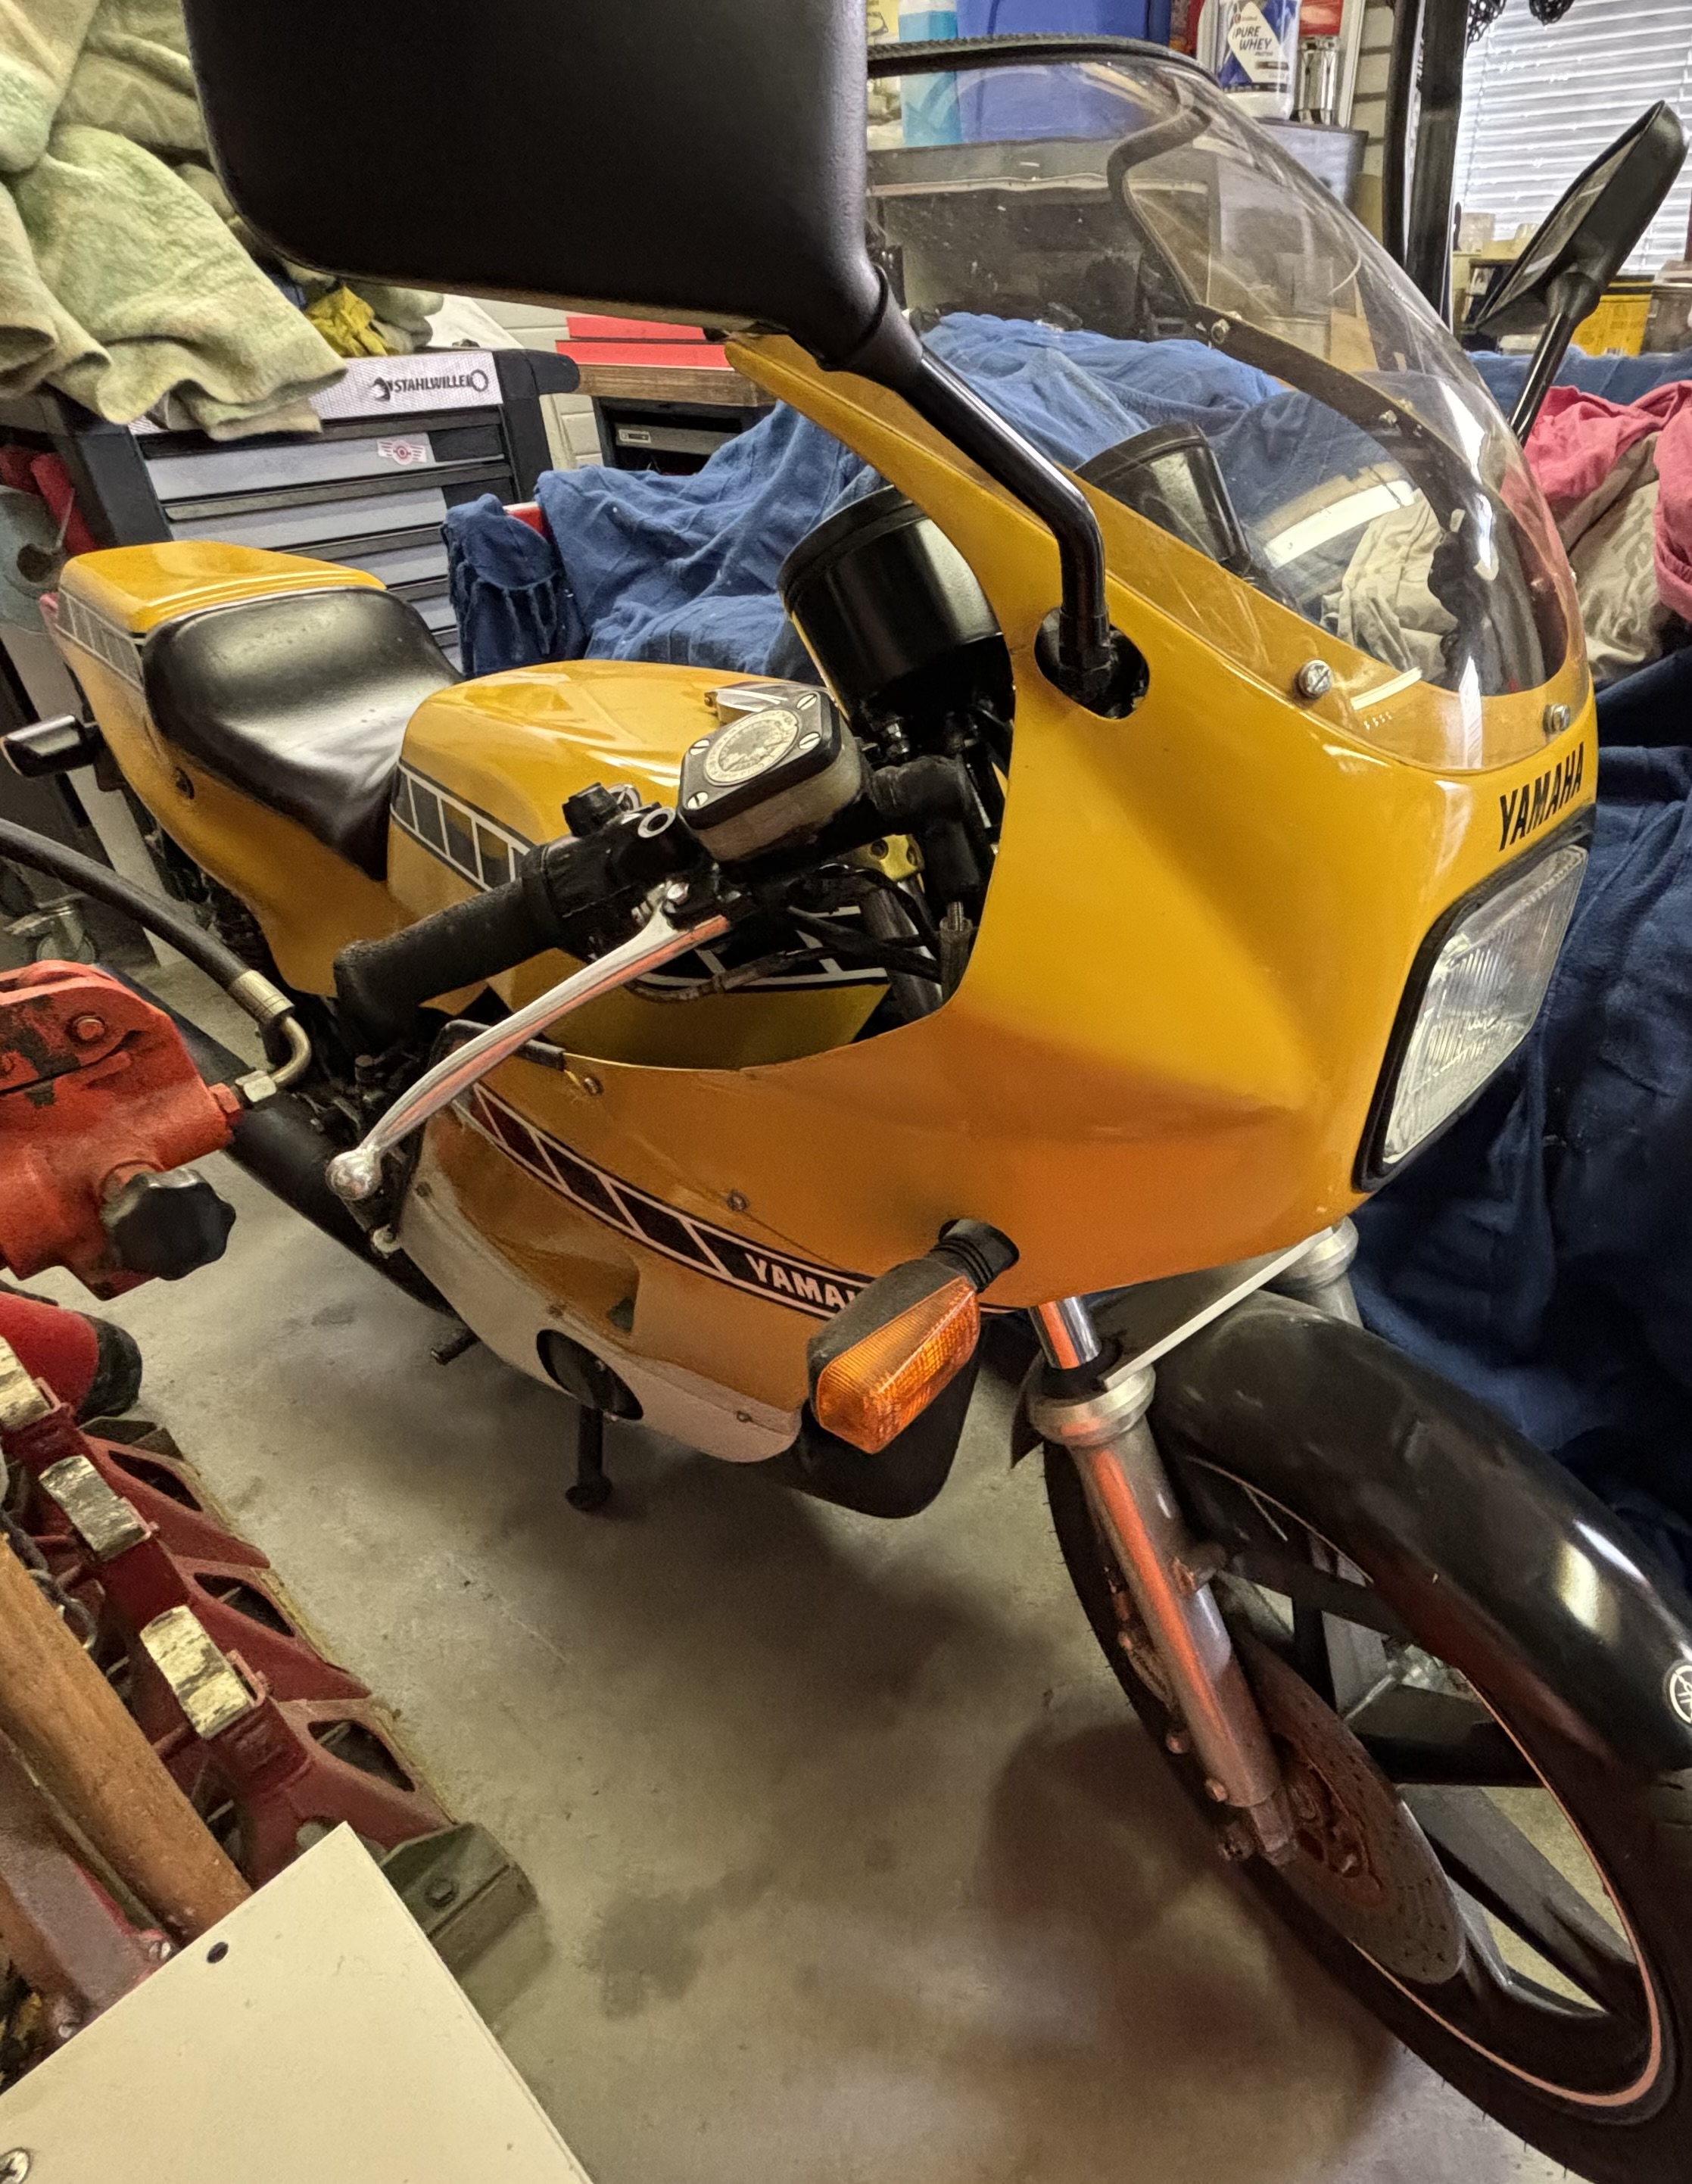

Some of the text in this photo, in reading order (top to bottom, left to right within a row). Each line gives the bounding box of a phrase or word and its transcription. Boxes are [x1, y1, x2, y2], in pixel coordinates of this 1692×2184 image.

[1235, 26, 1262, 39] PURE
[1239, 38, 1273, 51] WHEY
[394, 374, 466, 393] STAHLWILLE
[1499, 741, 1584, 852] YAMAHA
[744, 1252, 858, 1310] YAMA
